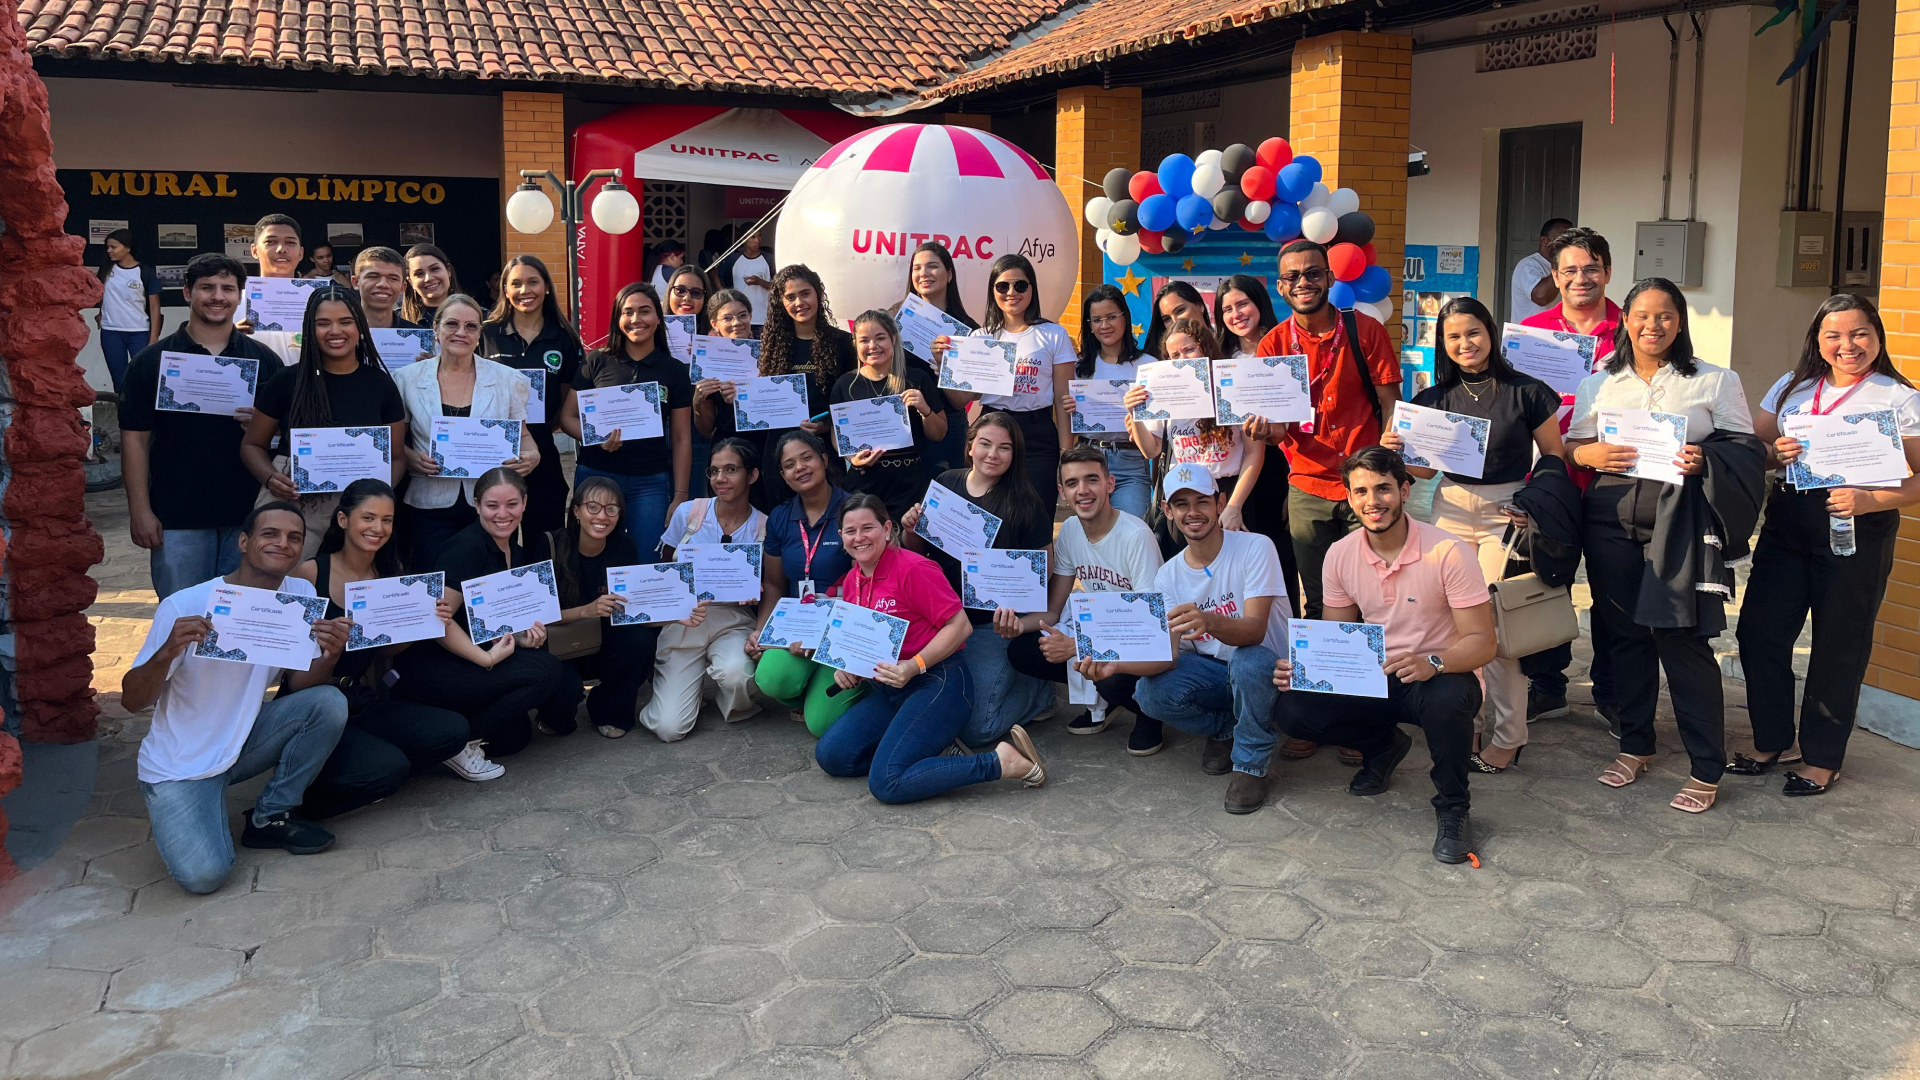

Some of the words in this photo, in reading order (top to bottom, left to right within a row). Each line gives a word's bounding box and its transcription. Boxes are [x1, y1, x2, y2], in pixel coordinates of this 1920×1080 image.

[670, 143, 780, 163] UNITPAC
[90, 171, 238, 198] MURAL
[269, 174, 446, 205] OLÍMPICO
[739, 197, 776, 206] UNITPAC
[1017, 237, 1056, 263] Afya
[1403, 258, 1425, 280] UL
[1016, 364, 1039, 377] ximo
[1247, 371, 1274, 379] Certificado
[859, 409, 881, 417] Certificado
[1426, 422, 1453, 432] Certificado
[1633, 425, 1660, 433] Certificado
[1171, 426, 1196, 439] Cada
[1826, 430, 1858, 438] Certificado
[1178, 468, 1192, 483] NY
[950, 507, 971, 521] Certificado
[497, 582, 523, 592] Certificado
[382, 591, 410, 599] Certificado
[874, 597, 896, 610] Afya
[250, 605, 283, 615] Certificado
[854, 621, 876, 631] Certificado
